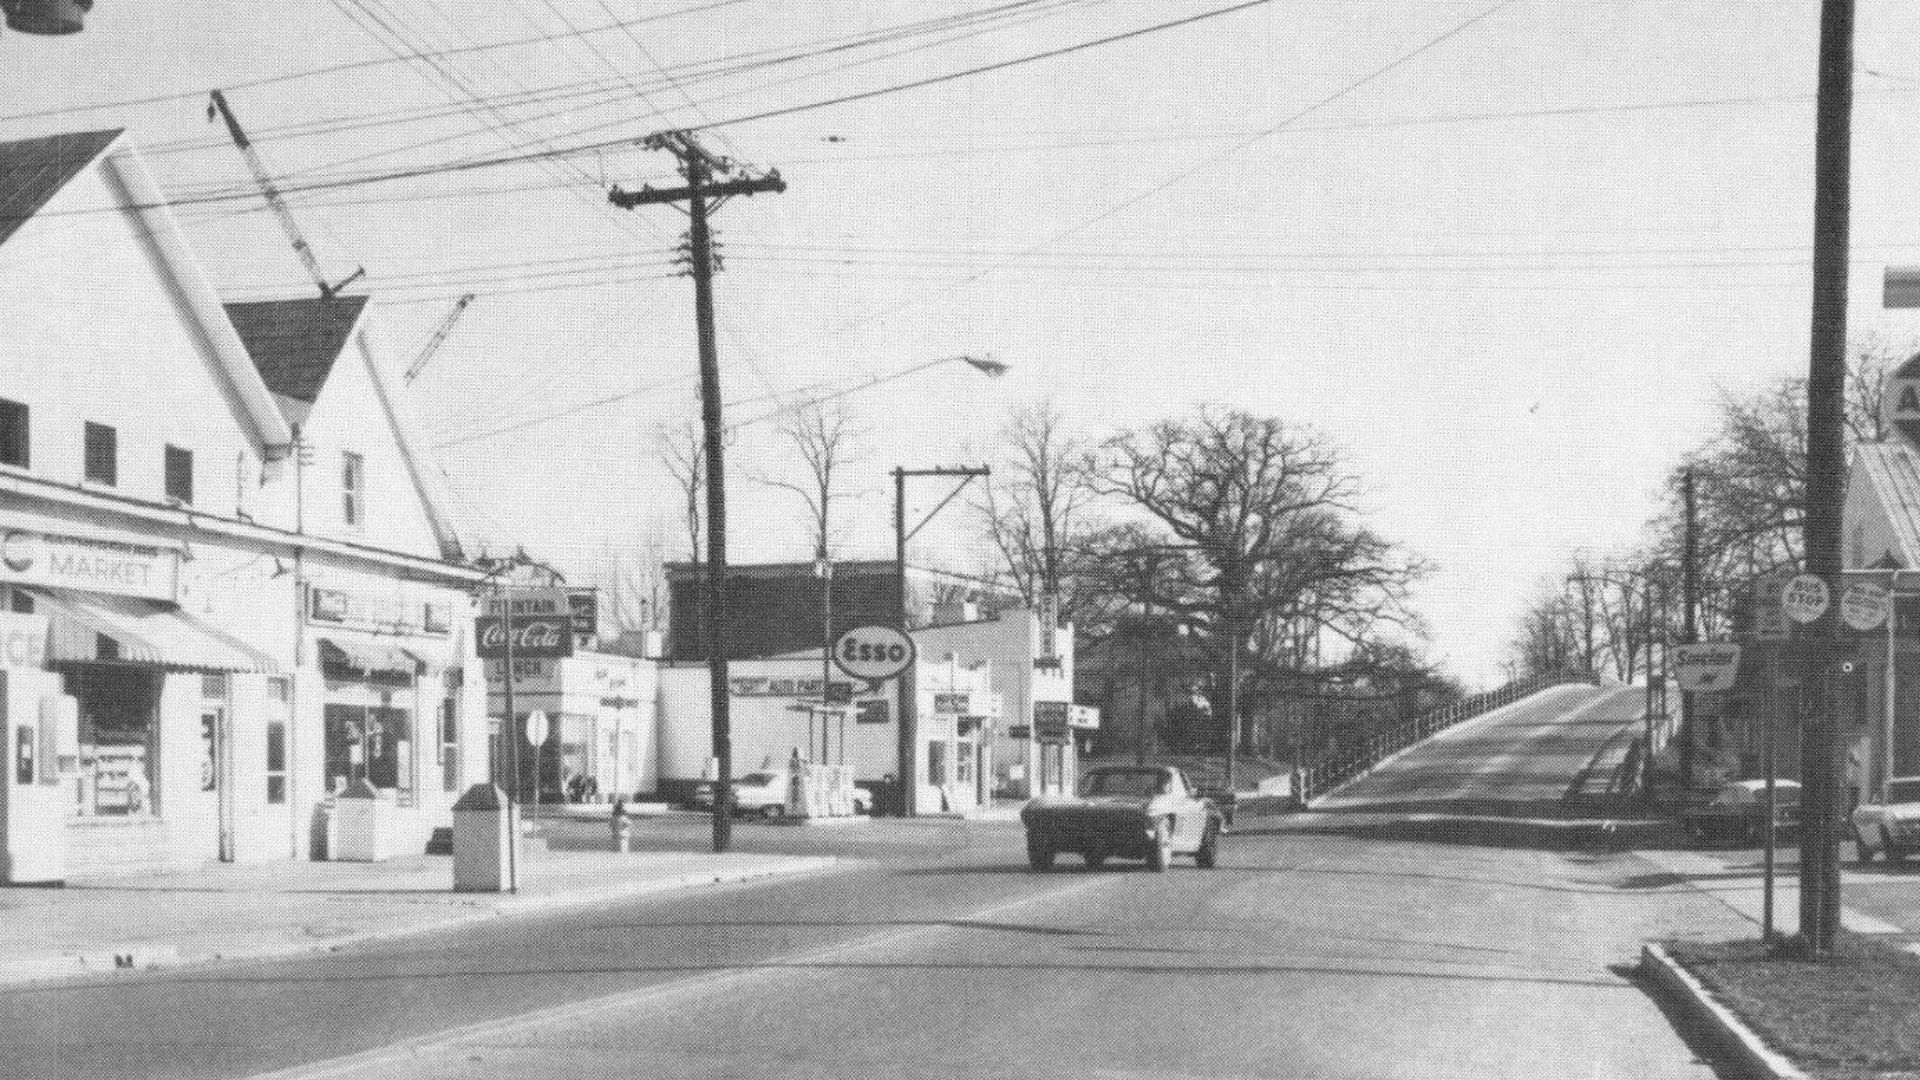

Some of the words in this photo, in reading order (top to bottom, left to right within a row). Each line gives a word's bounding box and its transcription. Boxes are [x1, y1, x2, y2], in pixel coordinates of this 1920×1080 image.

[49, 552, 151, 587] MARKET
[1794, 580, 1821, 593] BUS
[490, 599, 555, 613] FNTAIN
[1788, 592, 1825, 607] STOP
[843, 637, 905, 662] Esso
[496, 661, 541, 676] LNCH
